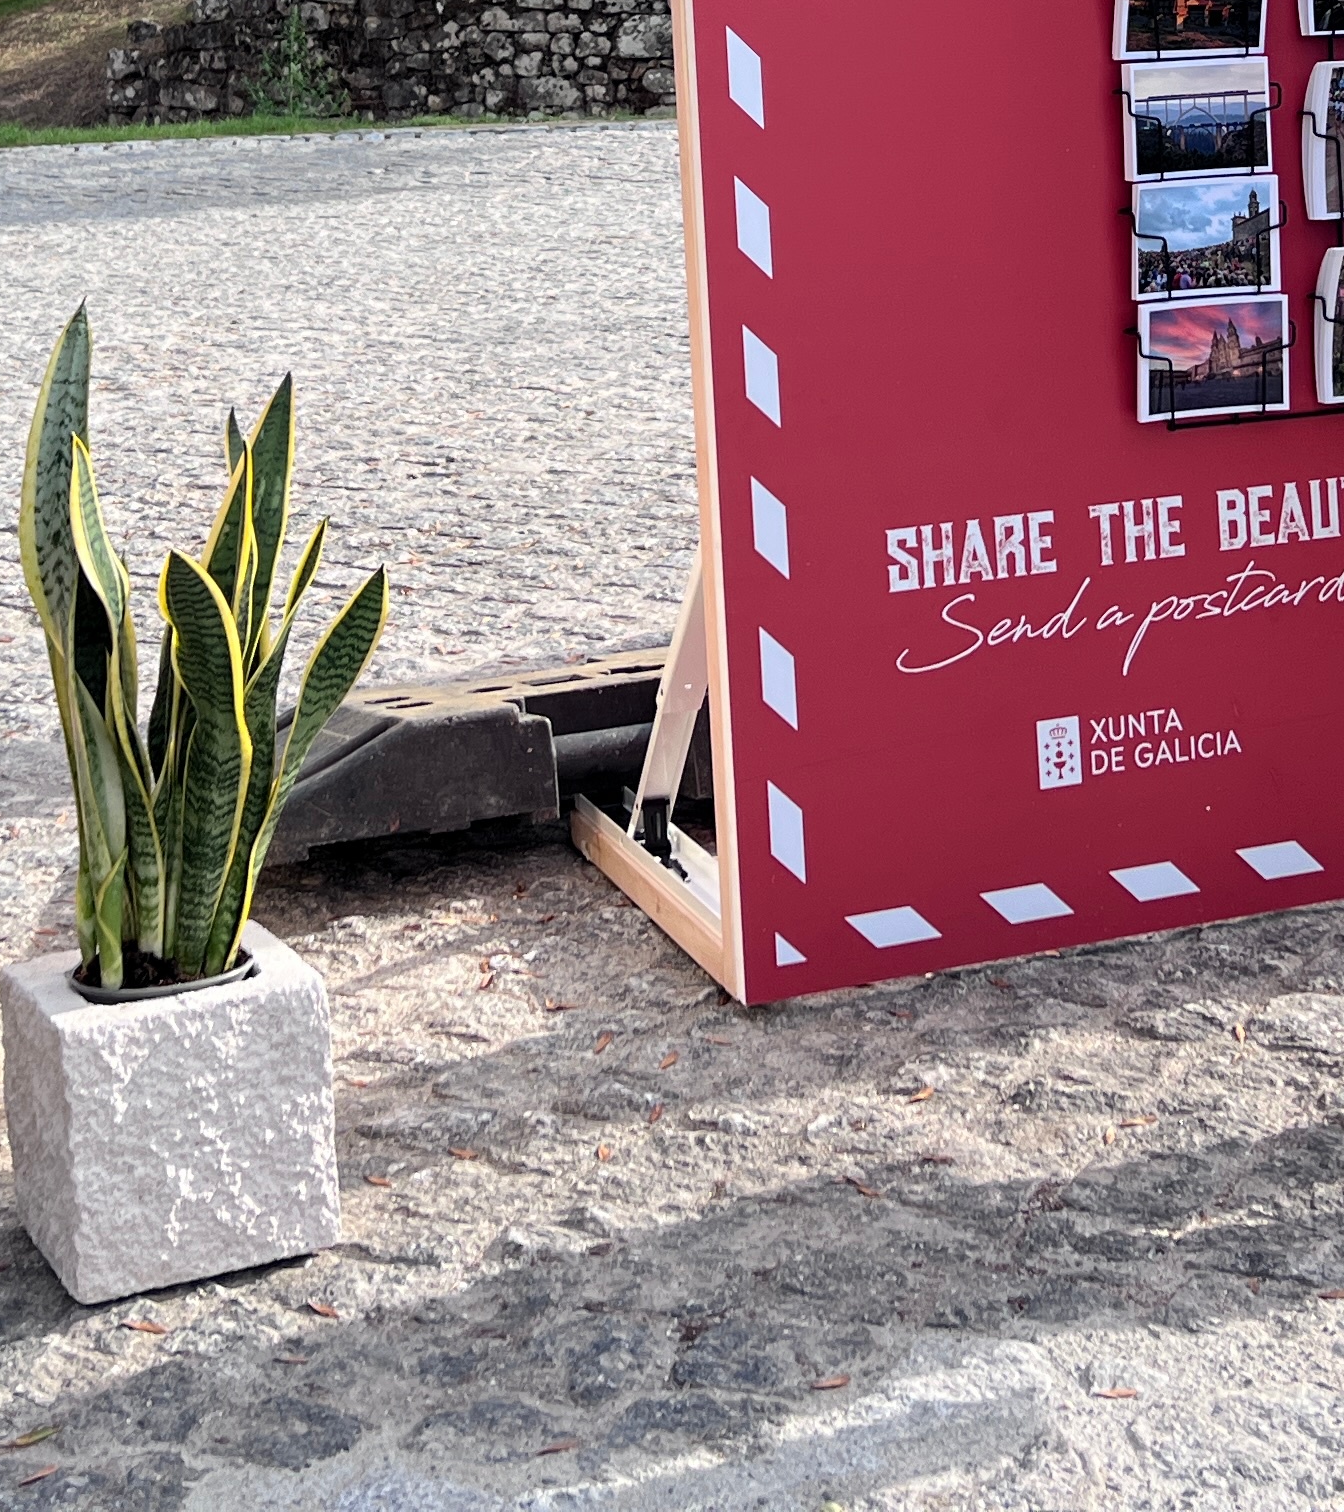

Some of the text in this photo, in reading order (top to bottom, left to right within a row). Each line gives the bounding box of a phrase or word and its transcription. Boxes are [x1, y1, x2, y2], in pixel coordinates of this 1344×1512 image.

[885, 509, 1058, 593] SHARE
[1088, 494, 1186, 566] THE
[896, 577, 1091, 673] Send
[1096, 605, 1135, 630] a
[1089, 707, 1183, 744] XUNTA
[1090, 729, 1242, 776] DE GALICIA
